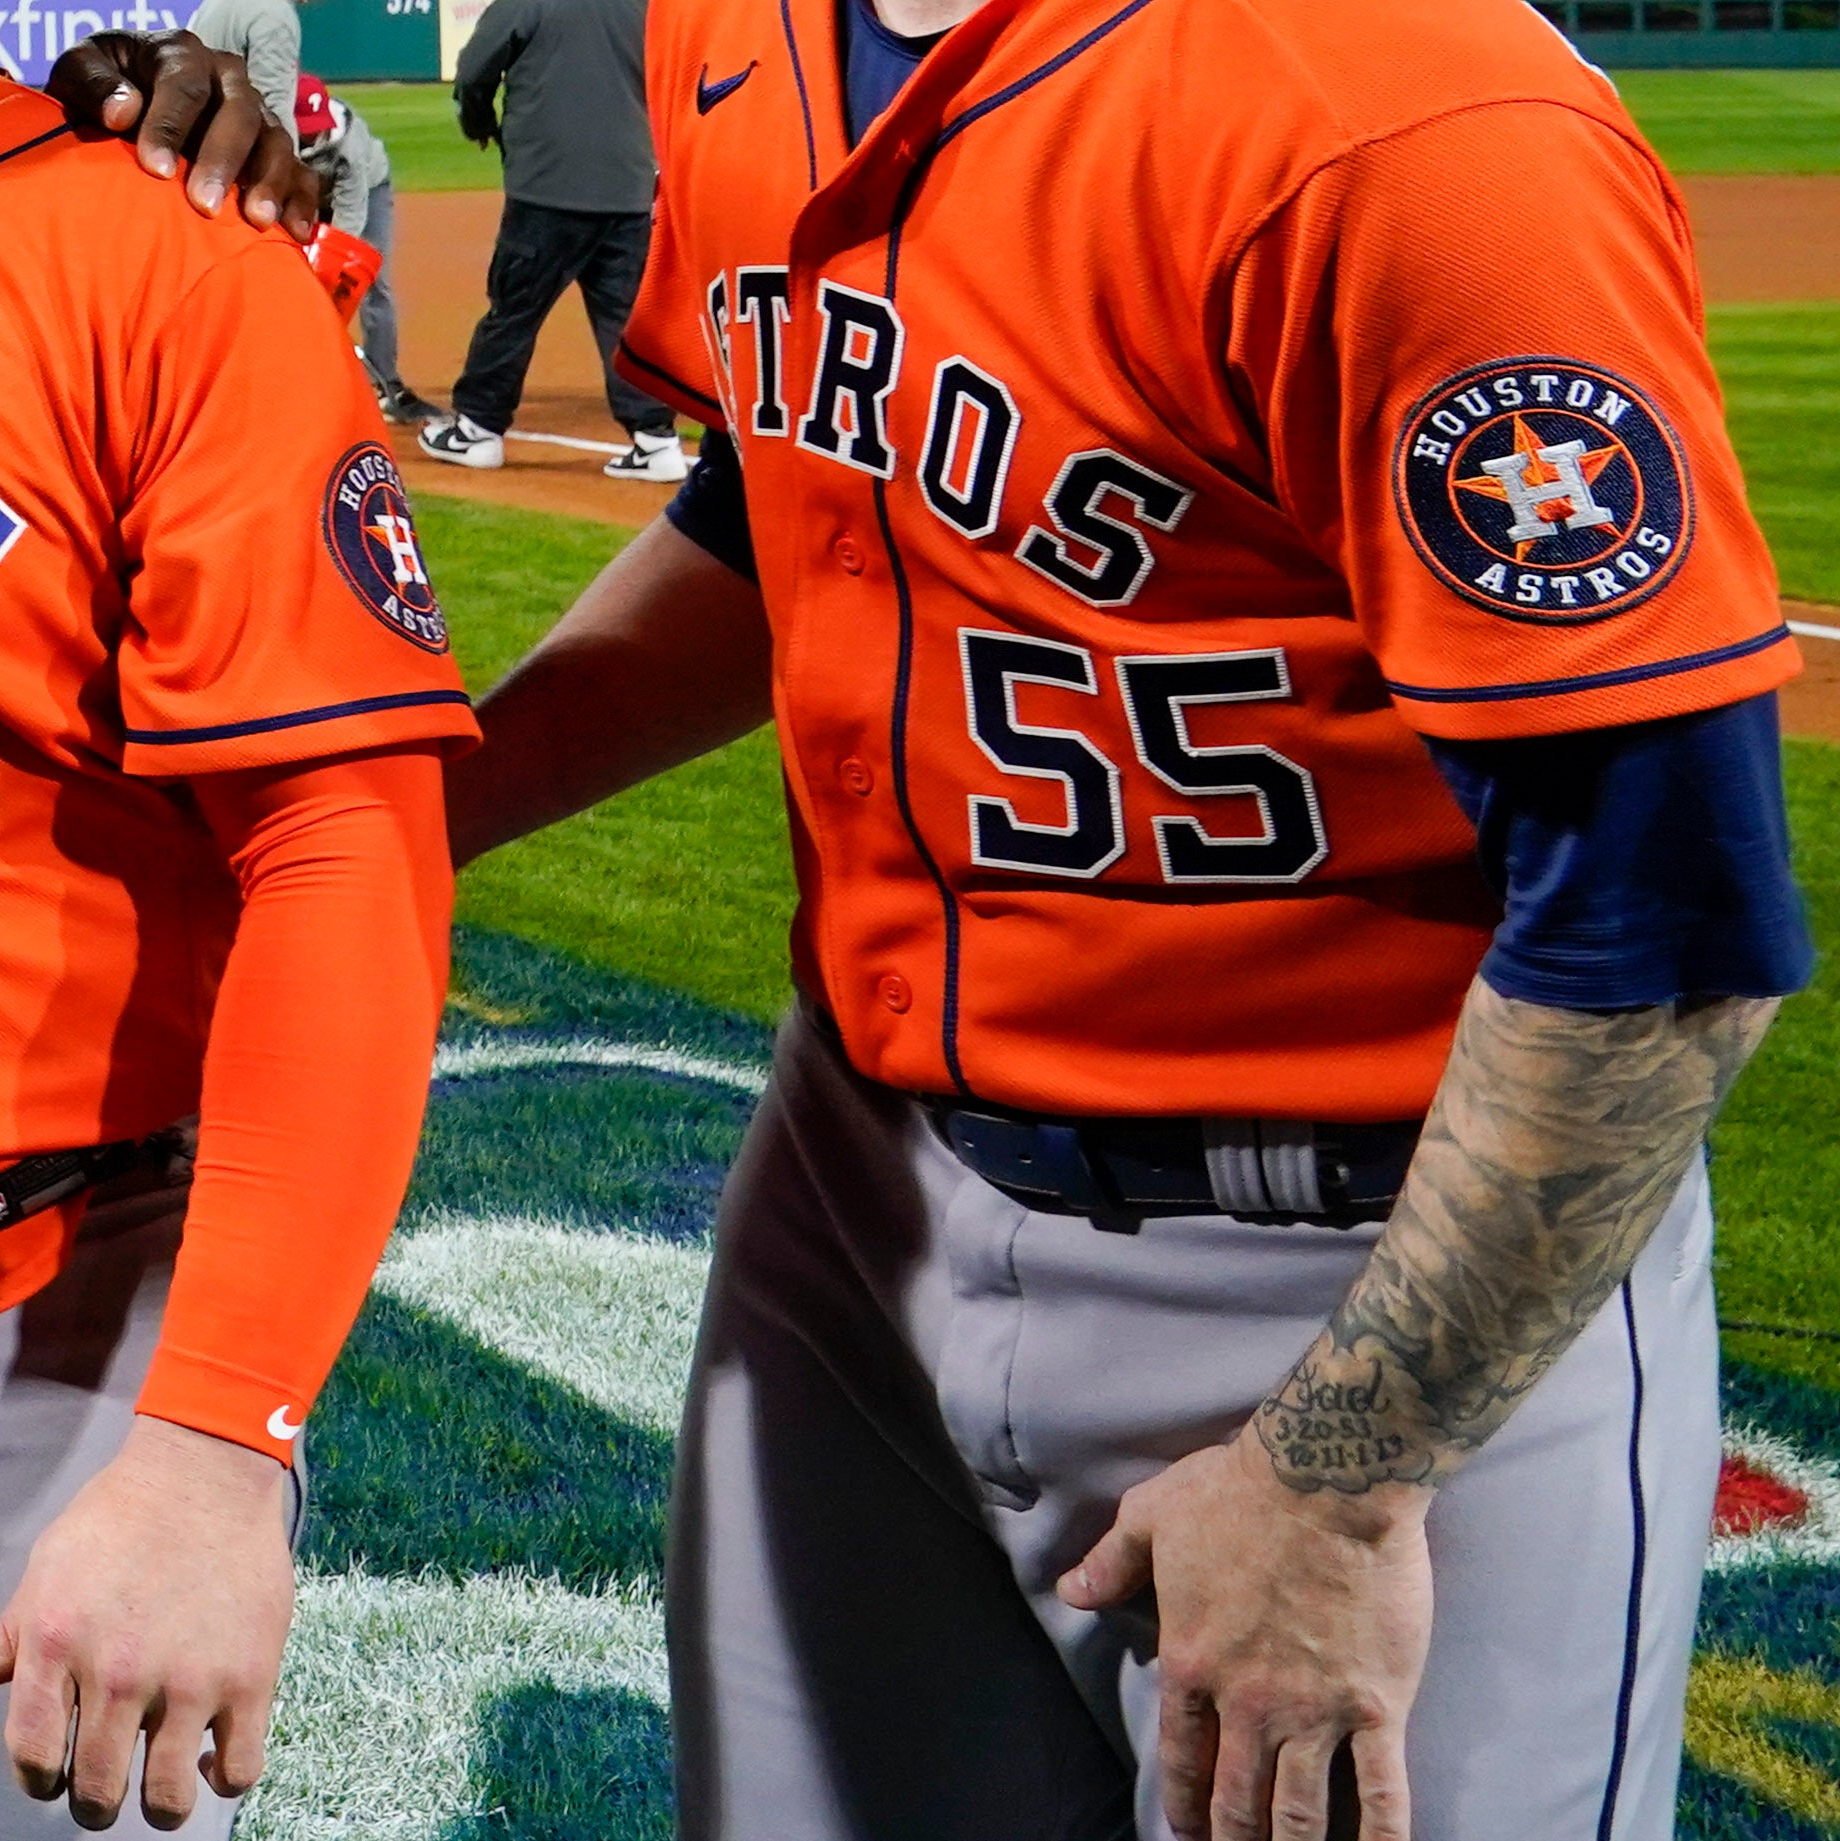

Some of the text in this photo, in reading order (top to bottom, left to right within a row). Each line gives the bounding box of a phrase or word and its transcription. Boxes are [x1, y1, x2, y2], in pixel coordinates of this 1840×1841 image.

[1413, 374, 1632, 466] HOUSTON
[1475, 526, 1672, 604] ASTROS
[957, 626, 1329, 883] 55
